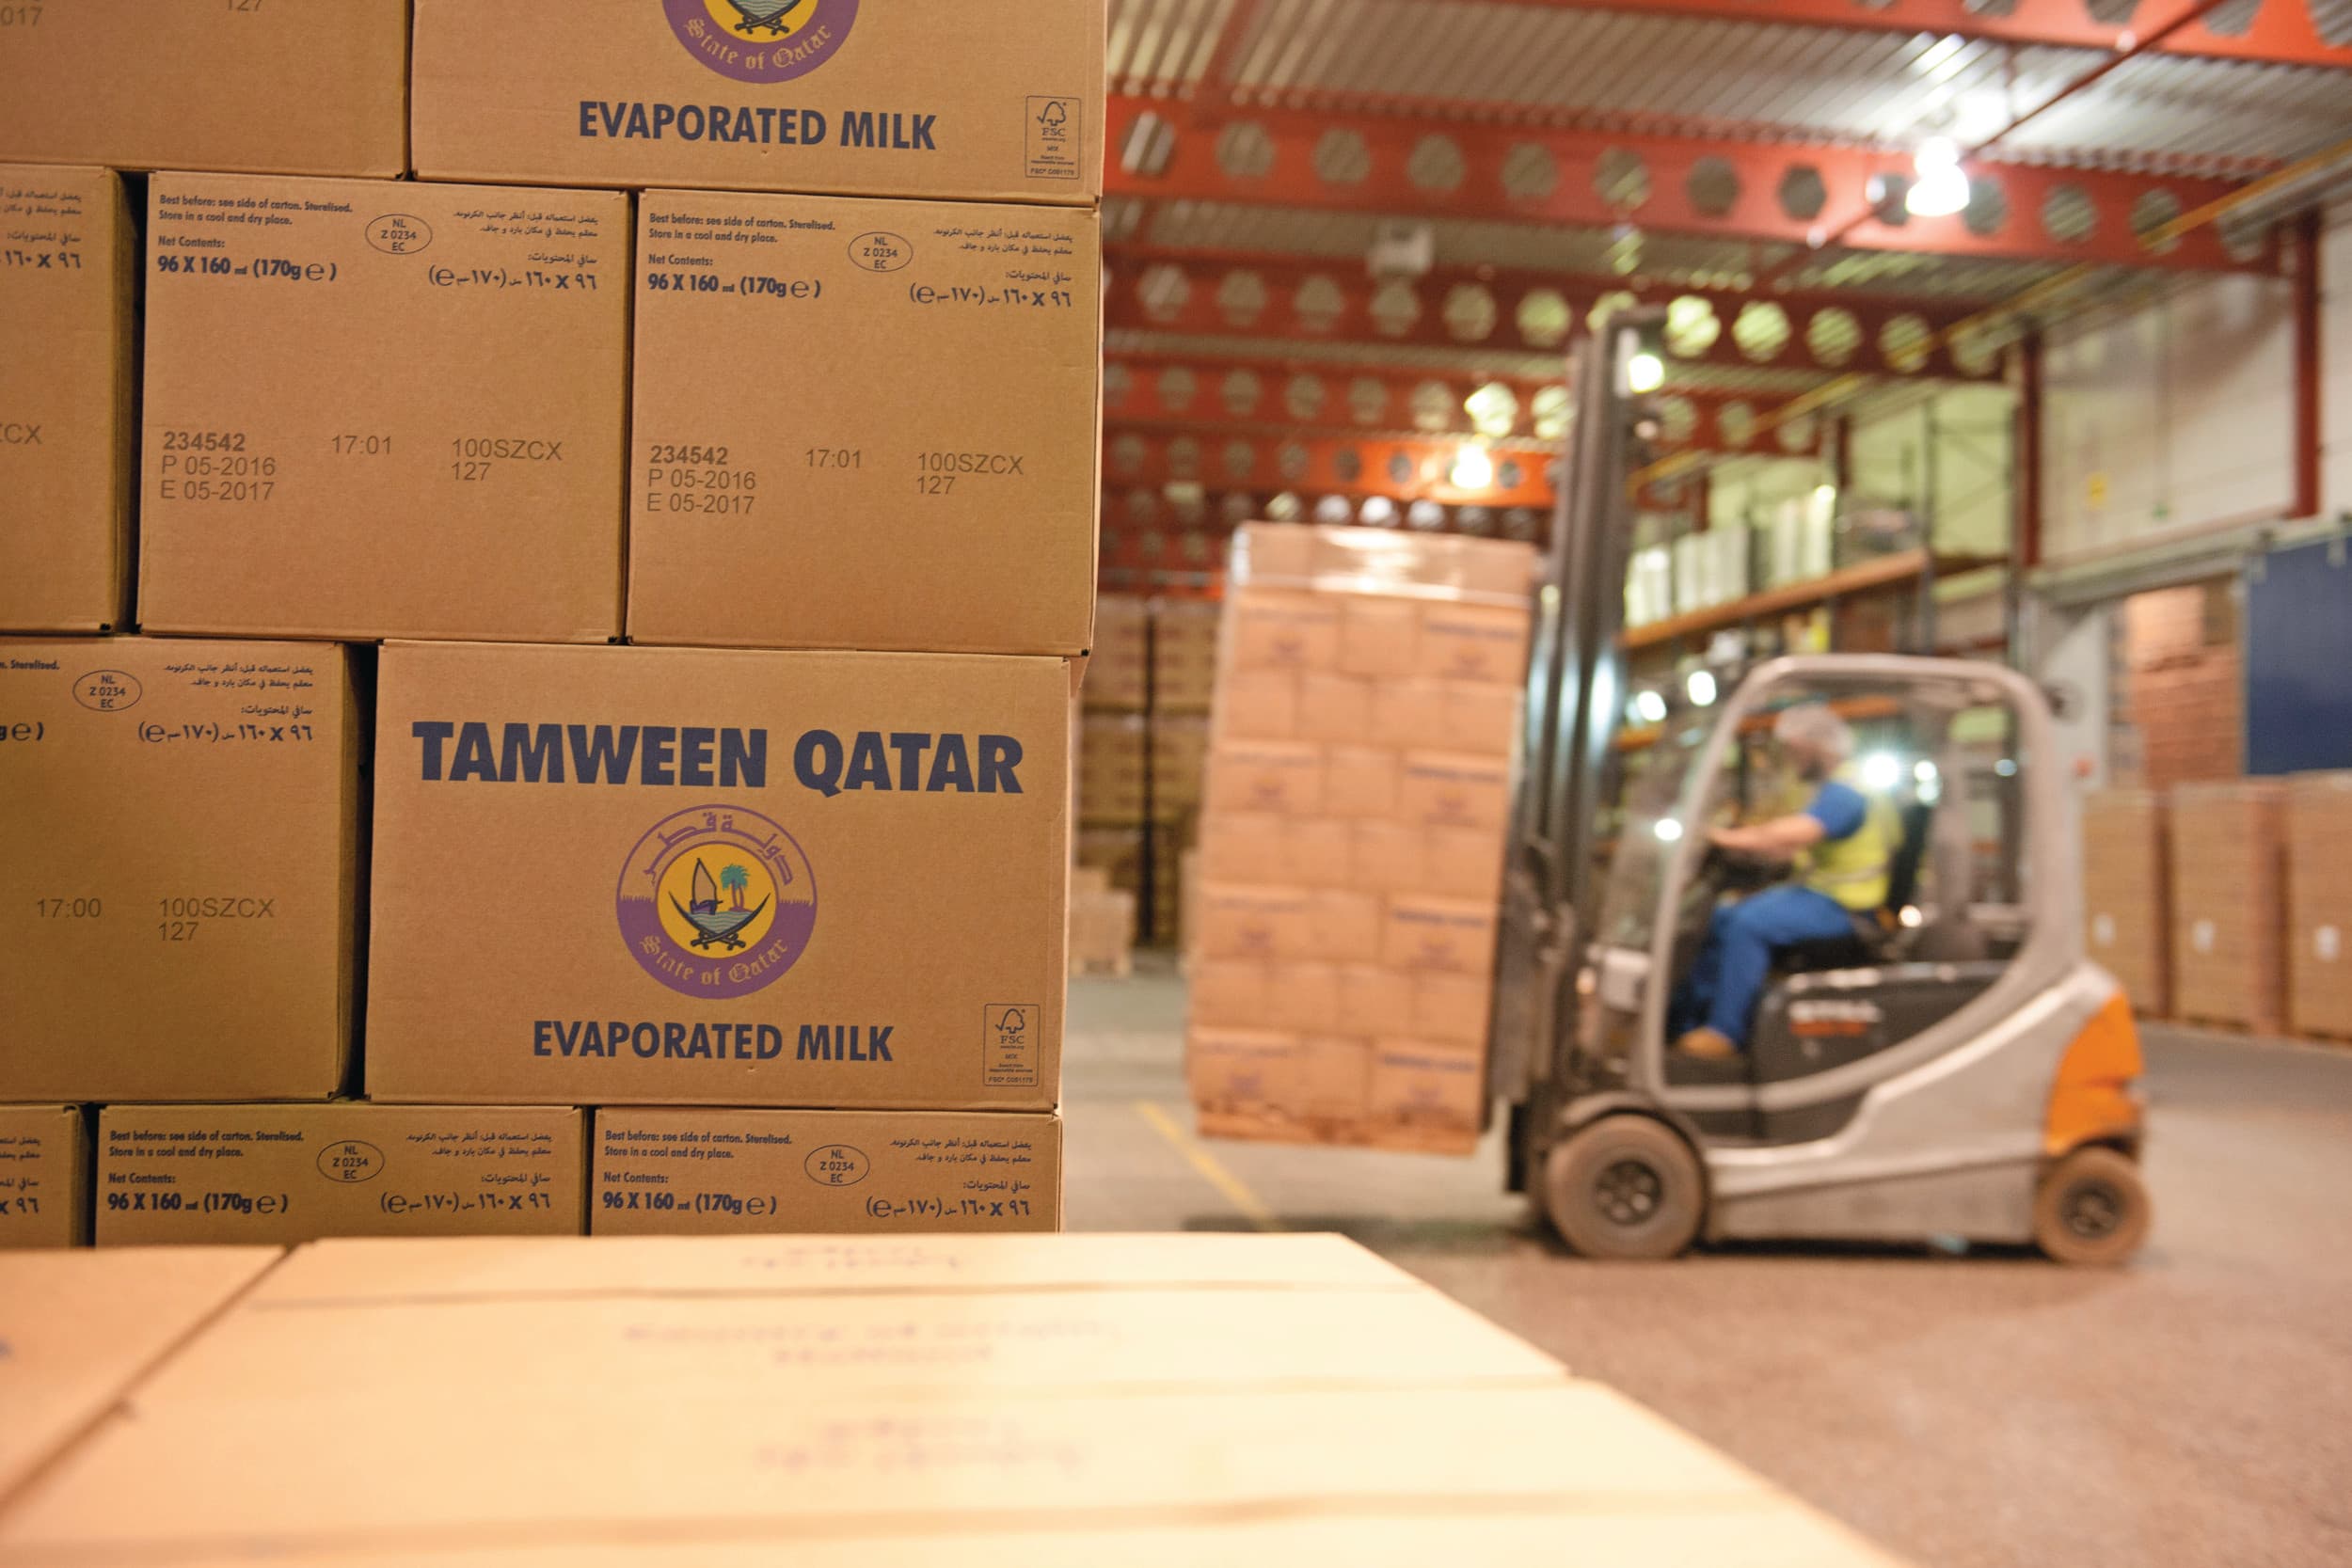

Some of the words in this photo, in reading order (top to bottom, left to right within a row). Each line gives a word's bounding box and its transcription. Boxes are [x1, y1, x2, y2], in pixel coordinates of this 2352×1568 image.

[683, 18, 739, 65] State
[745, 52, 765, 70] of
[772, 24, 832, 68] Qatar
[579, 101, 827, 146] EVAPORATED
[839, 110, 937, 150] MILK
[1041, 127, 1067, 137] FSC
[159, 194, 181, 205] Best
[182, 195, 216, 207] before:
[217, 198, 235, 208] see
[236, 197, 257, 209] side
[258, 198, 269, 209] of
[158, 209, 183, 221] Store
[184, 211, 195, 221] in
[205, 211, 226, 222] cool
[226, 212, 246, 223] and
[246, 213, 263, 226] dry
[392, 218, 407, 229] NL
[649, 212, 670, 224] Best
[671, 213, 704, 225] before:
[706, 217, 723, 226] see
[723, 215, 743, 227] side
[744, 215, 755, 227] of
[157, 234, 177, 246] Net
[178, 235, 226, 248] Contents:
[380, 229, 389, 240] Z
[389, 230, 417, 242] 0234
[648, 228, 673, 239] Store
[674, 229, 684, 240] in
[693, 230, 713, 241] cool
[714, 230, 733, 242] and
[734, 230, 750, 244] dry
[874, 237, 888, 246] NL
[391, 243, 405, 252] EC
[863, 246, 870, 257] Z
[872, 247, 898, 259] 0234
[157, 255, 180, 273] 96
[182, 255, 196, 274] X
[200, 256, 231, 275] 160
[647, 253, 666, 265] Net
[667, 253, 714, 266] Contents:
[874, 261, 887, 270] EC
[647, 273, 669, 291] 96
[672, 273, 685, 292] X
[690, 274, 720, 293] 160
[0, 422, 42, 445] CX
[162, 430, 246, 452] 234542
[331, 434, 391, 455] 17:01
[452, 437, 563, 465] 100SZCX
[649, 444, 728, 466] 234542
[805, 448, 862, 469] 17:01
[161, 454, 178, 475] P
[184, 455, 277, 477] 05-2016
[451, 461, 492, 482] 127
[917, 451, 1025, 476] 100SZCX
[647, 467, 663, 488] P
[670, 468, 756, 491] 05-2016
[916, 474, 957, 495] 127
[160, 479, 177, 500] E
[183, 480, 275, 501] 05-2017
[646, 492, 663, 512] E
[669, 492, 755, 515] 05-2017
[100, 674, 117, 685] NL
[88, 686, 97, 697] Z
[98, 686, 127, 697] 0234
[100, 699, 114, 708] EC
[411, 721, 768, 788] TAMWEEN
[793, 729, 1025, 799] QATAR
[37, 897, 102, 919] 17:00
[159, 896, 275, 919] 100SZCX
[158, 921, 199, 942] 127
[640, 934, 693, 980] State
[701, 967, 721, 985] of
[728, 939, 788, 983] Qatar
[533, 1020, 783, 1060] EVAPORATED
[796, 1024, 895, 1062] MILK
[1000, 1035, 1025, 1045] FSC
[109, 1130, 131, 1142] Best
[133, 1129, 167, 1142] before:
[168, 1132, 186, 1142] see
[187, 1130, 208, 1142] side
[208, 1130, 220, 1142] of
[605, 1130, 626, 1141] Best
[627, 1130, 660, 1142] before:
[661, 1133, 678, 1142] see
[679, 1131, 700, 1143] side
[700, 1131, 711, 1143] of
[343, 1145, 359, 1156] NL
[604, 1145, 628, 1157] Store
[629, 1146, 640, 1157] in
[649, 1146, 669, 1158] cool
[670, 1146, 689, 1158] and
[690, 1147, 706, 1161] dry
[830, 1148, 845, 1160] NL
[332, 1157, 341, 1167] Z
[342, 1157, 369, 1167] 0234
[819, 1161, 828, 1171] Z
[828, 1161, 855, 1172] 0234
[107, 1172, 127, 1184] Net
[128, 1172, 176, 1184] Contents:
[343, 1170, 357, 1180] EC
[603, 1171, 621, 1183] Net
[623, 1171, 670, 1184] Contents:
[830, 1175, 843, 1184] EC
[106, 1192, 130, 1211] 96
[133, 1192, 146, 1211] X
[151, 1192, 183, 1211] 160
[602, 1191, 625, 1210] 96
[627, 1191, 640, 1210] X
[644, 1192, 675, 1211] 160
